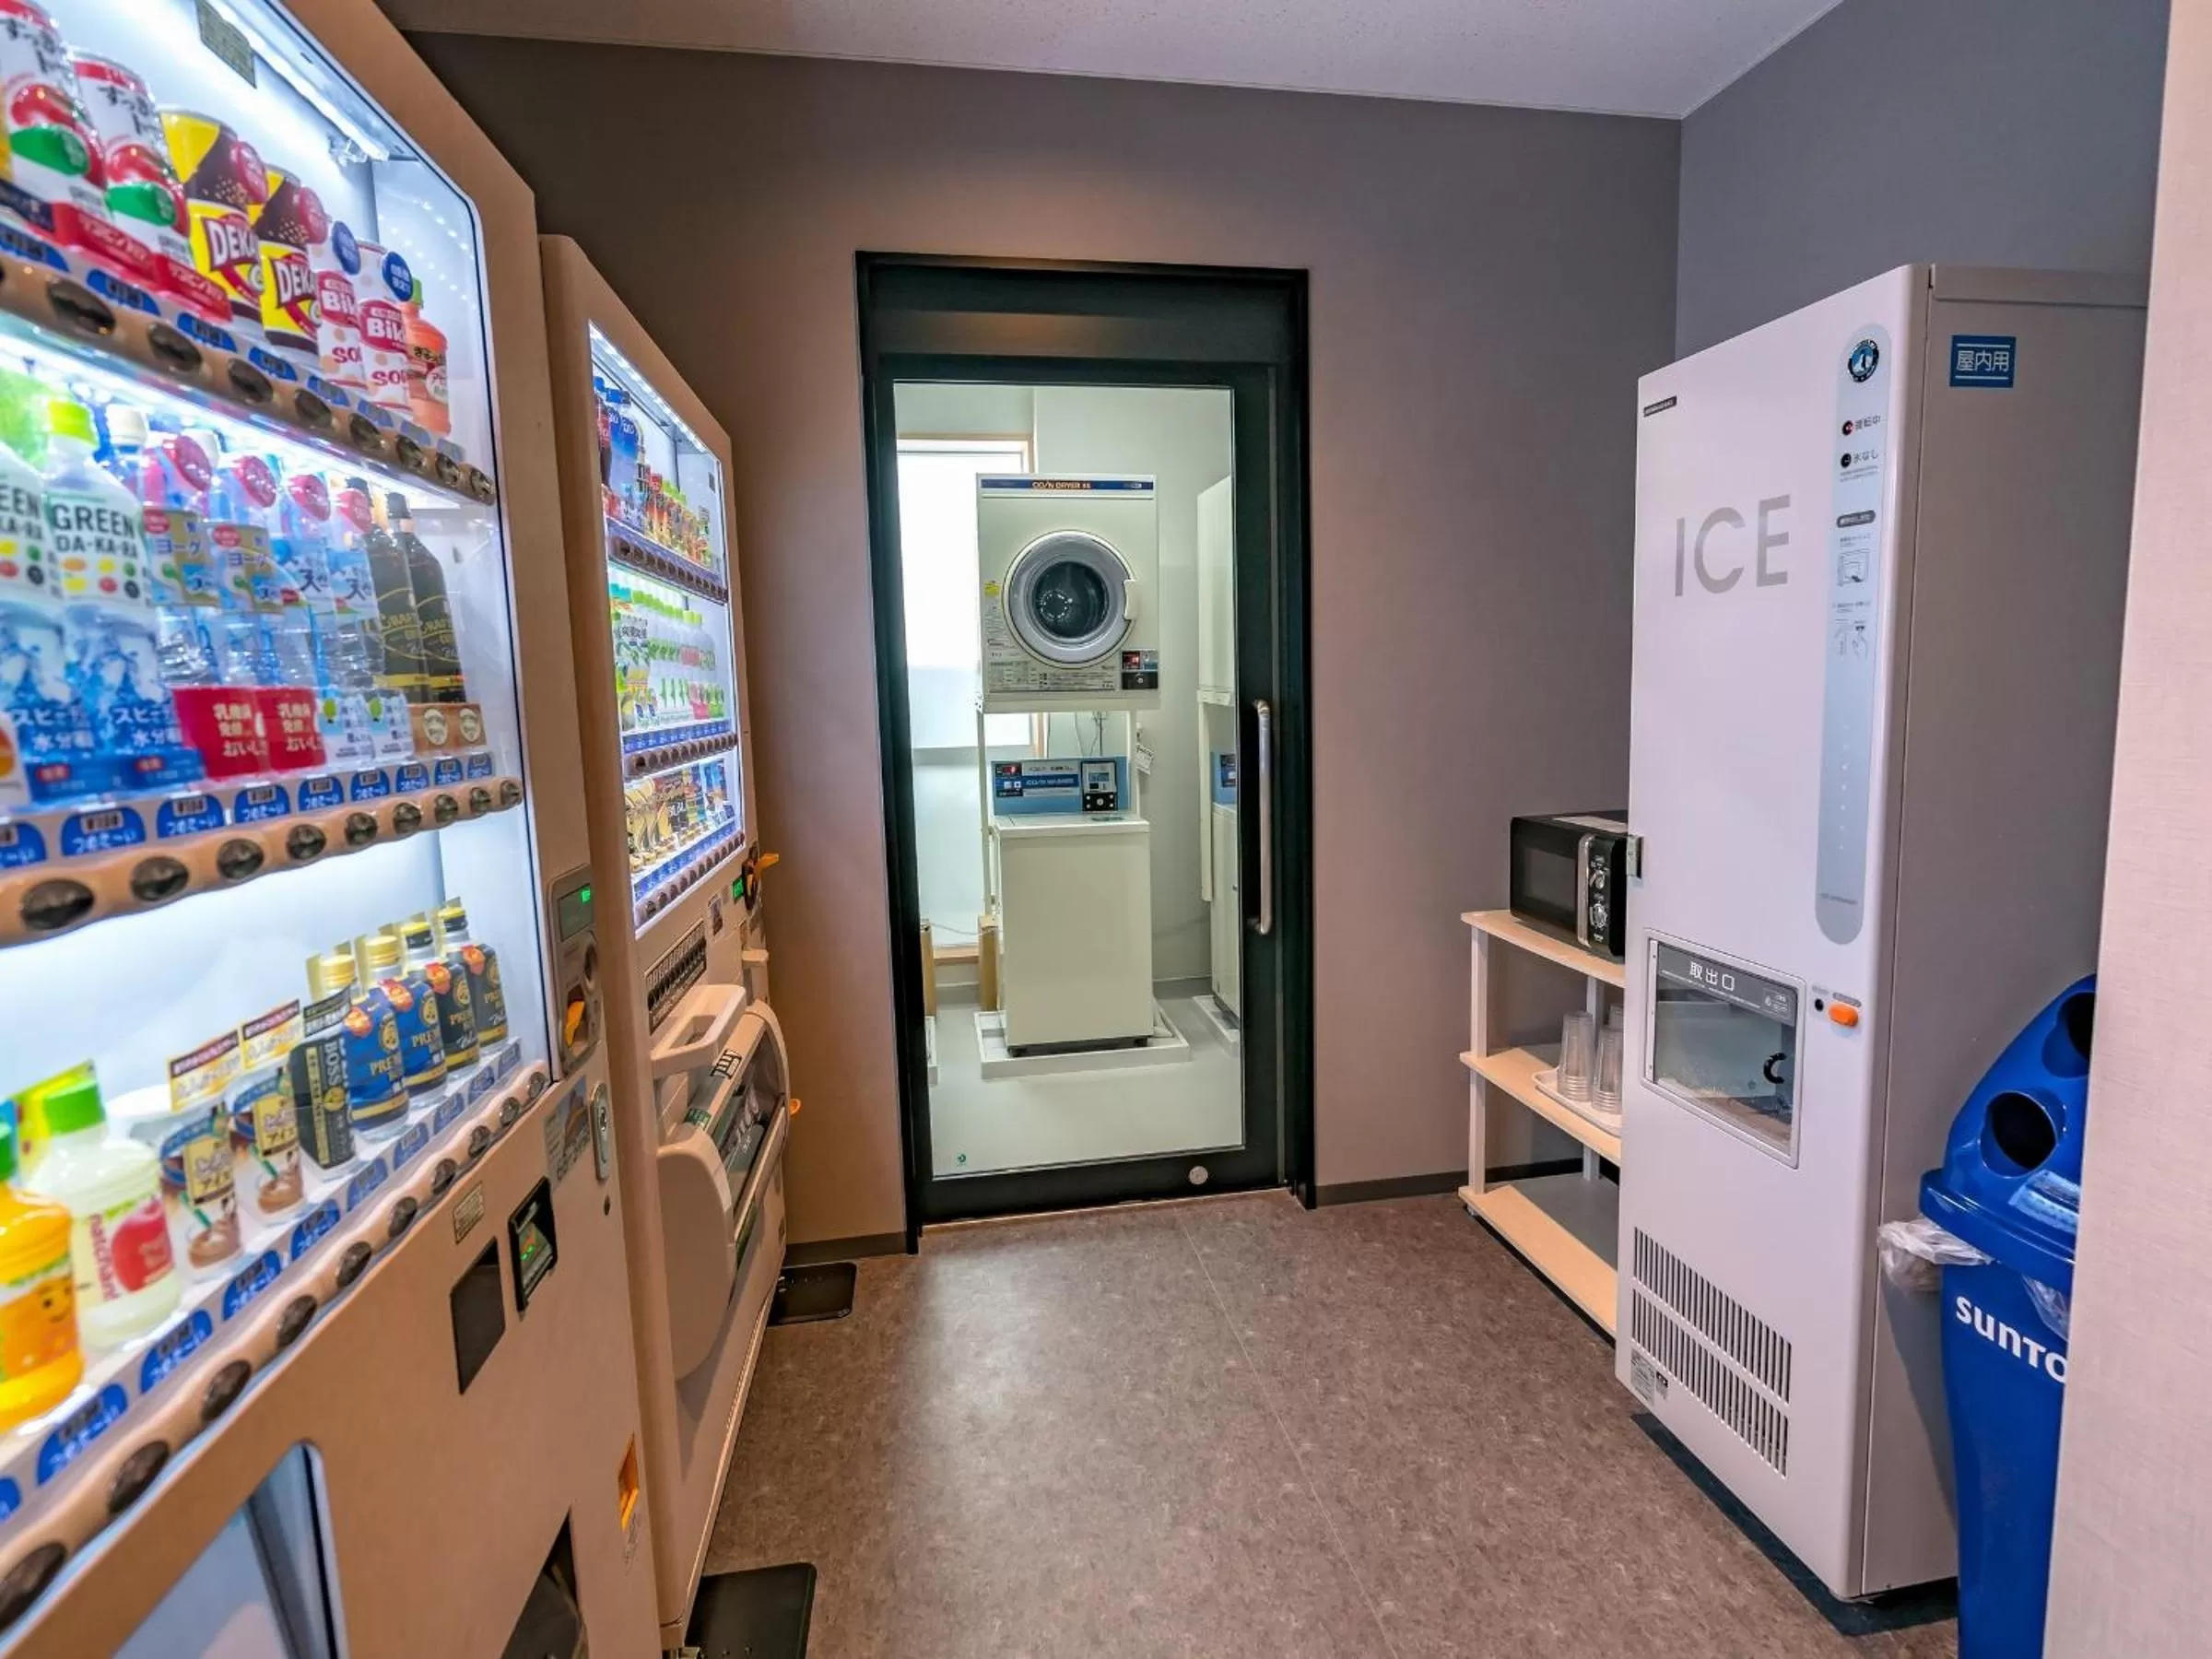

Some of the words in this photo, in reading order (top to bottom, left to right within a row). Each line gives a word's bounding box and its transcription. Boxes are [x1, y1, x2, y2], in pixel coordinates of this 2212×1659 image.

[1955, 349, 2010, 372] 屋内用
[53, 503, 135, 539] GREEN
[1674, 494, 1792, 597] ICE
[1688, 961, 1735, 992] 取出口
[324, 1041, 343, 1087] BOSS
